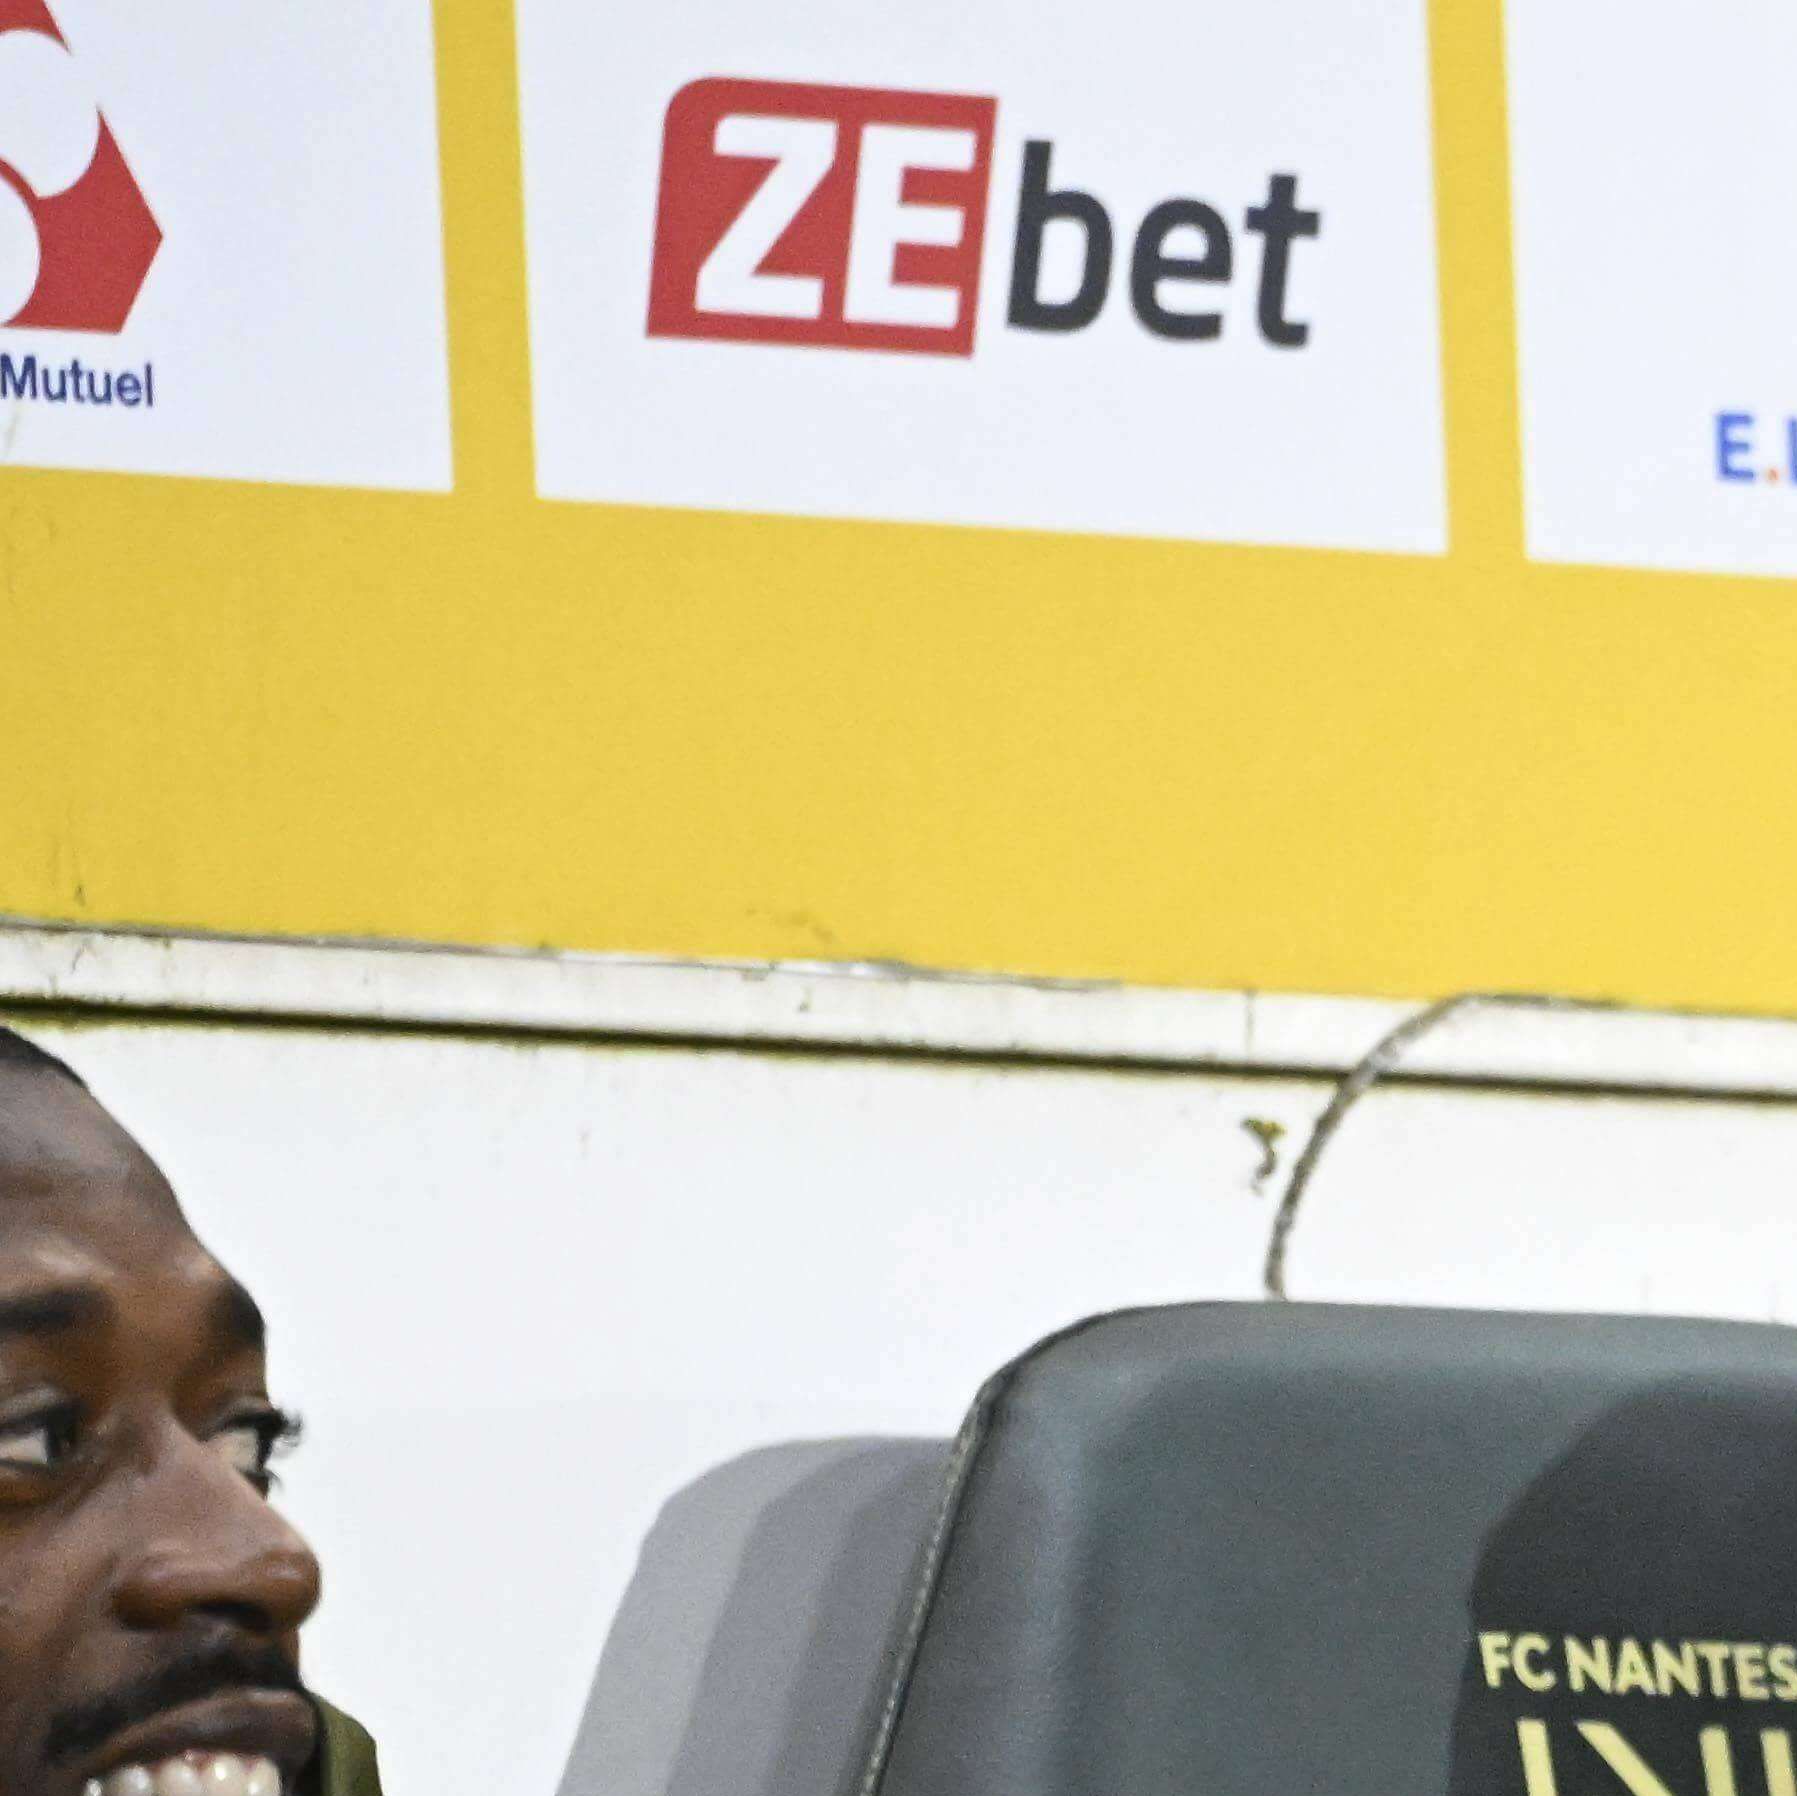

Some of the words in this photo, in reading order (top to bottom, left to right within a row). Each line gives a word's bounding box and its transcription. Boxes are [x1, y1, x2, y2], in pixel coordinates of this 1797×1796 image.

[694, 112, 1321, 350] ZEbet
[0, 352, 154, 407] Mutuel
[1479, 1630, 1557, 1692] FC
